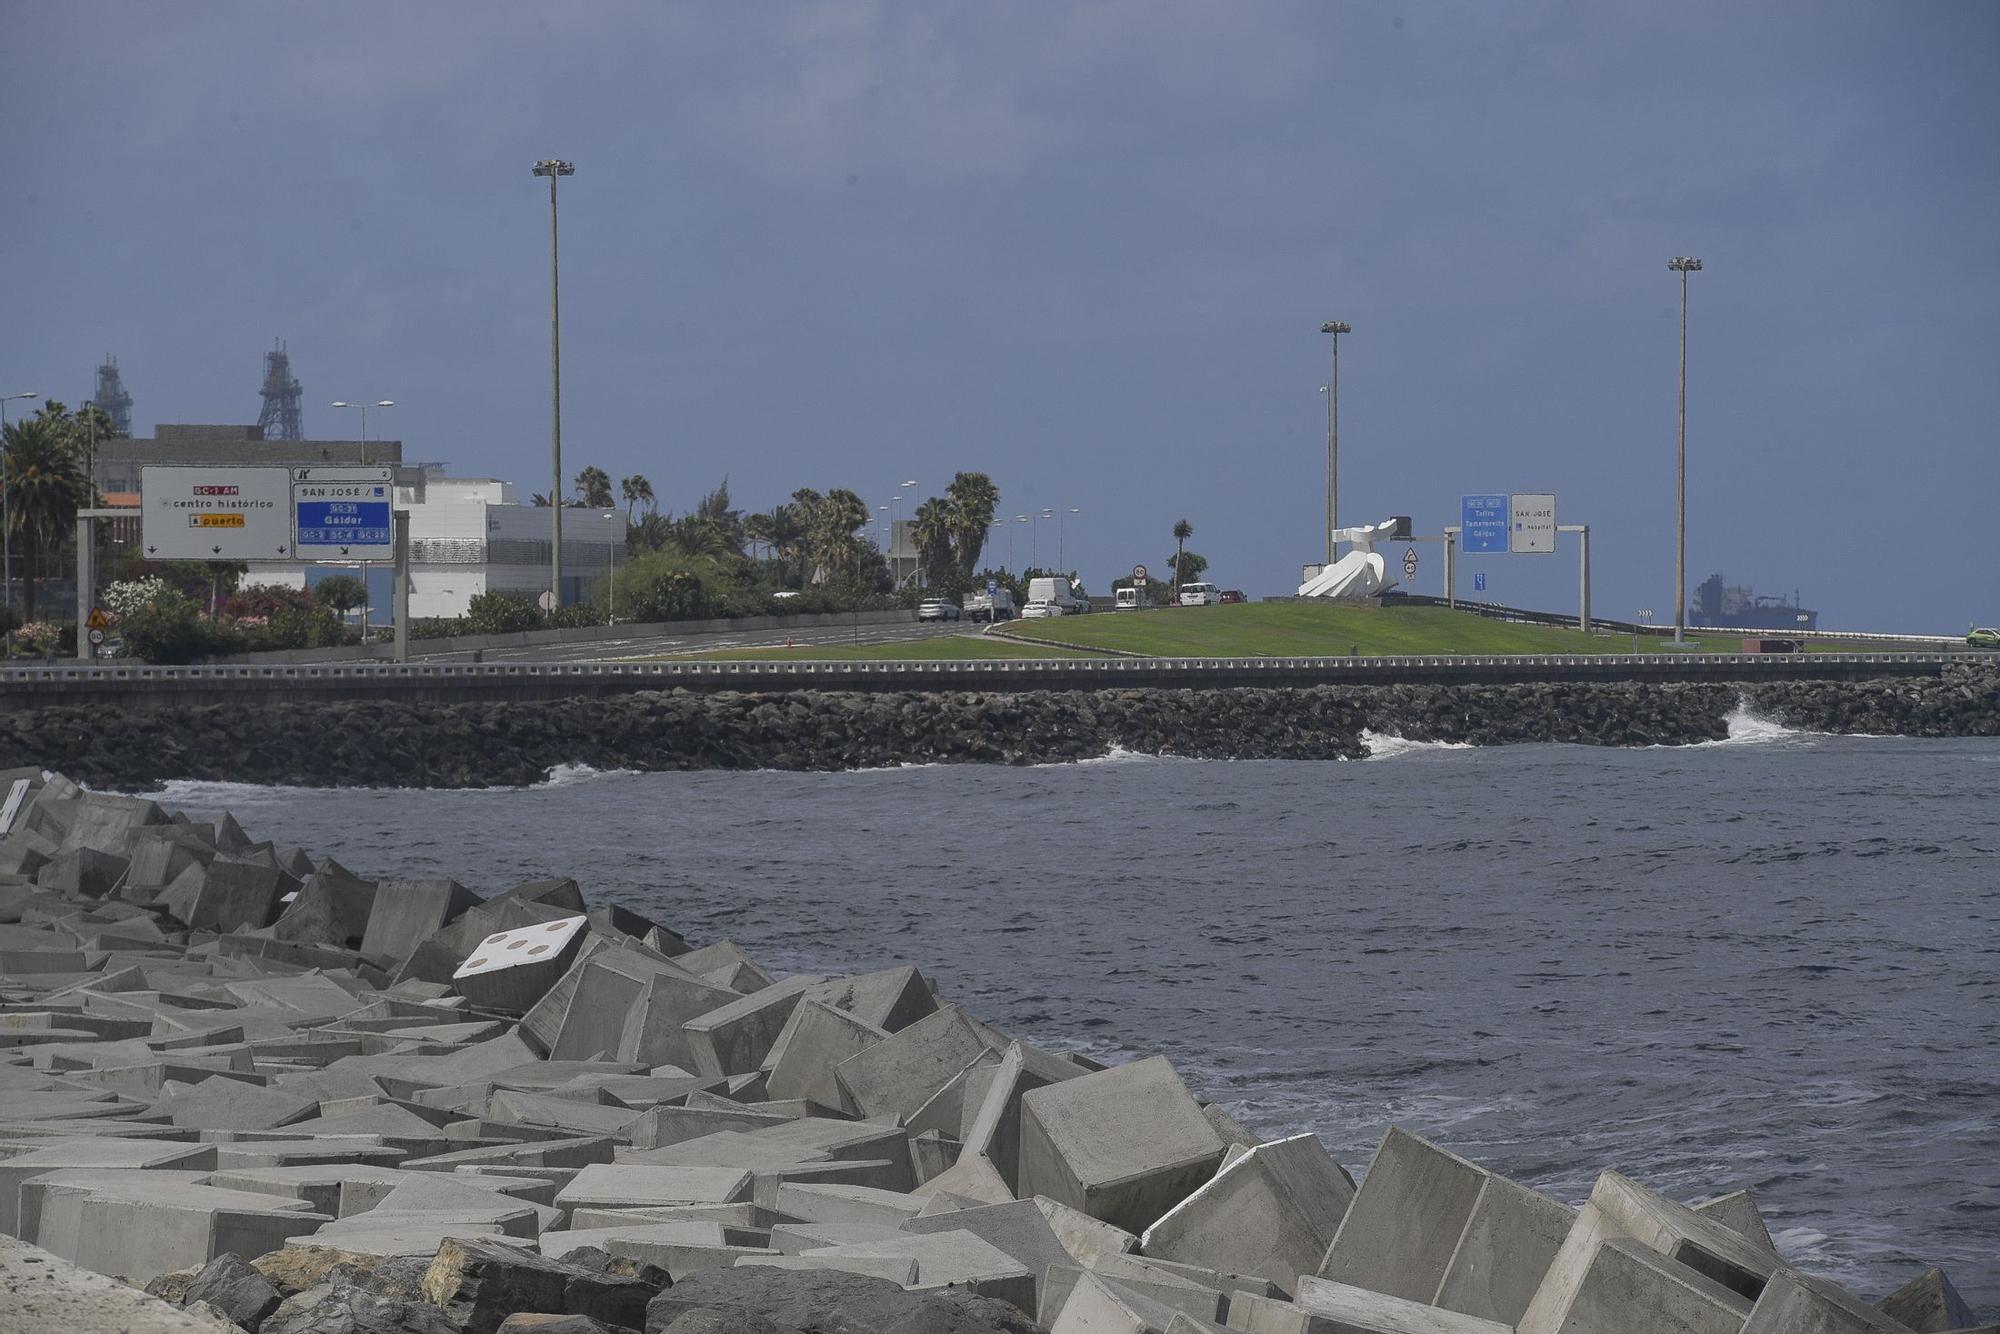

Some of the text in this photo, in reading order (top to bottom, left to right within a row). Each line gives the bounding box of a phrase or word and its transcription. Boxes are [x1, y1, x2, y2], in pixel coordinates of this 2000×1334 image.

[194, 487, 238, 495] GC-1 AM
[302, 488, 325, 496] SAN
[331, 487, 360, 496] JOSÉ
[173, 499, 274, 508] centro histórico
[203, 517, 244, 527] puerto
[324, 515, 362, 525] Gáldar
